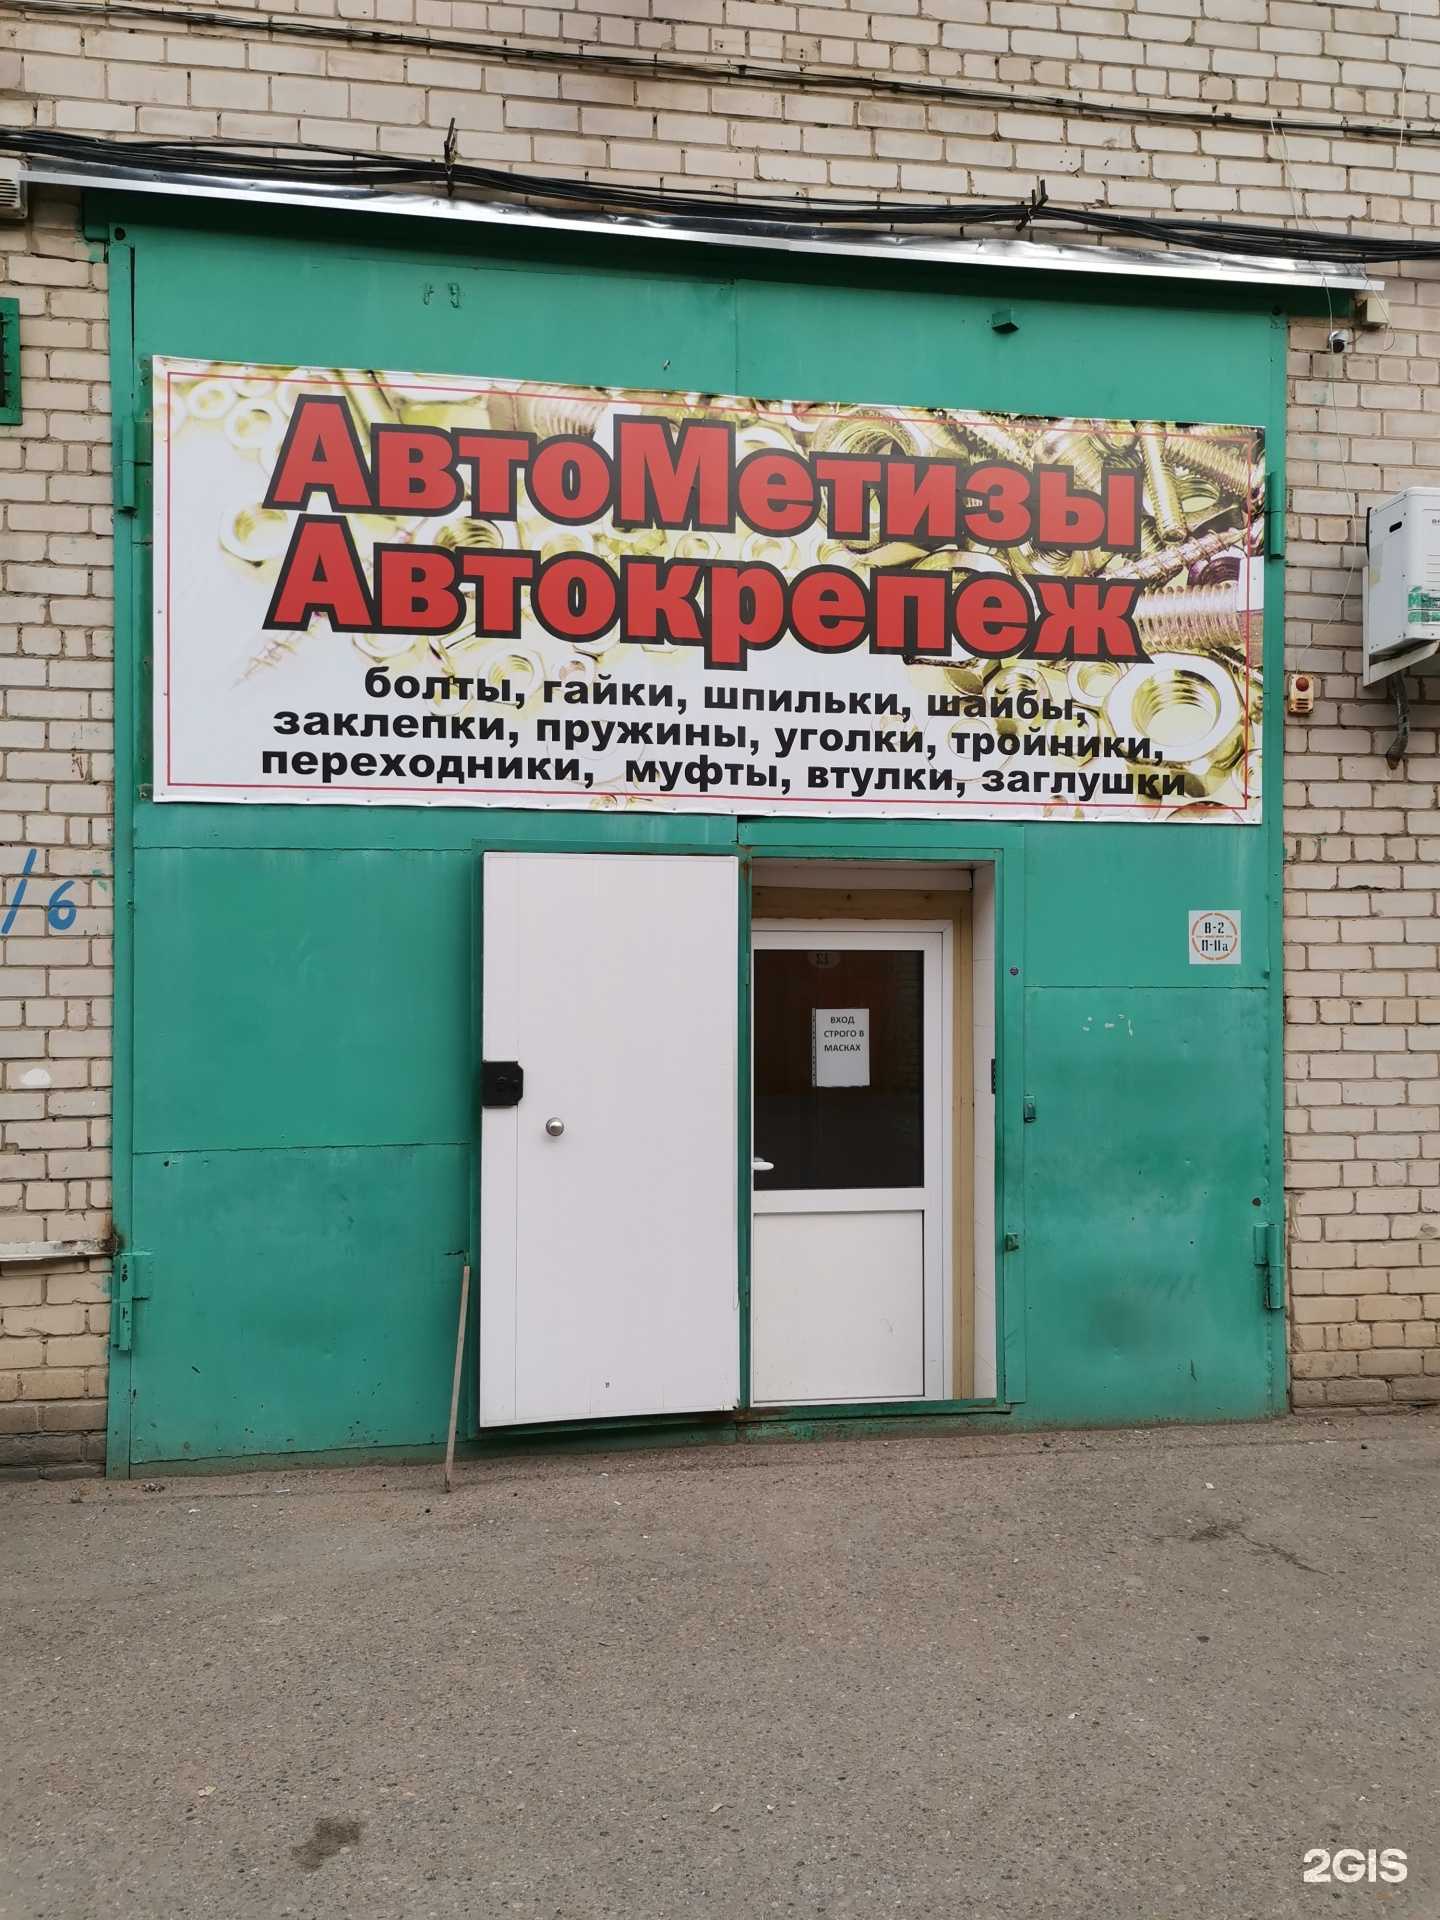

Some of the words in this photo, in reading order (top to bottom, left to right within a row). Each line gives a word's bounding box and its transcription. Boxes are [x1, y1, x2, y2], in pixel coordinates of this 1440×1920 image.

[262, 393, 1143, 552] АвтоМетизы
[262, 512, 1154, 671] Автокрепеж
[364, 666, 525, 709] болты,
[543, 673, 687, 715] гайки,
[704, 686, 911, 723] шпильки,
[927, 689, 1087, 726] шайбы,
[272, 711, 519, 749] заклепки,
[536, 718, 759, 756] пружины,
[774, 727, 937, 760] уголки,
[951, 727, 1164, 763] тройники,
[262, 750, 594, 789] переходники,
[625, 754, 792, 796] муфты,
[807, 765, 966, 798] втулки,
[981, 769, 1186, 801] заглушки
[823, 1030, 857, 1038] СТРОГО
[859, 1030, 865, 1038] В
[830, 1016, 855, 1025] ВХОД
[824, 1044, 861, 1052] МАСКАХ
